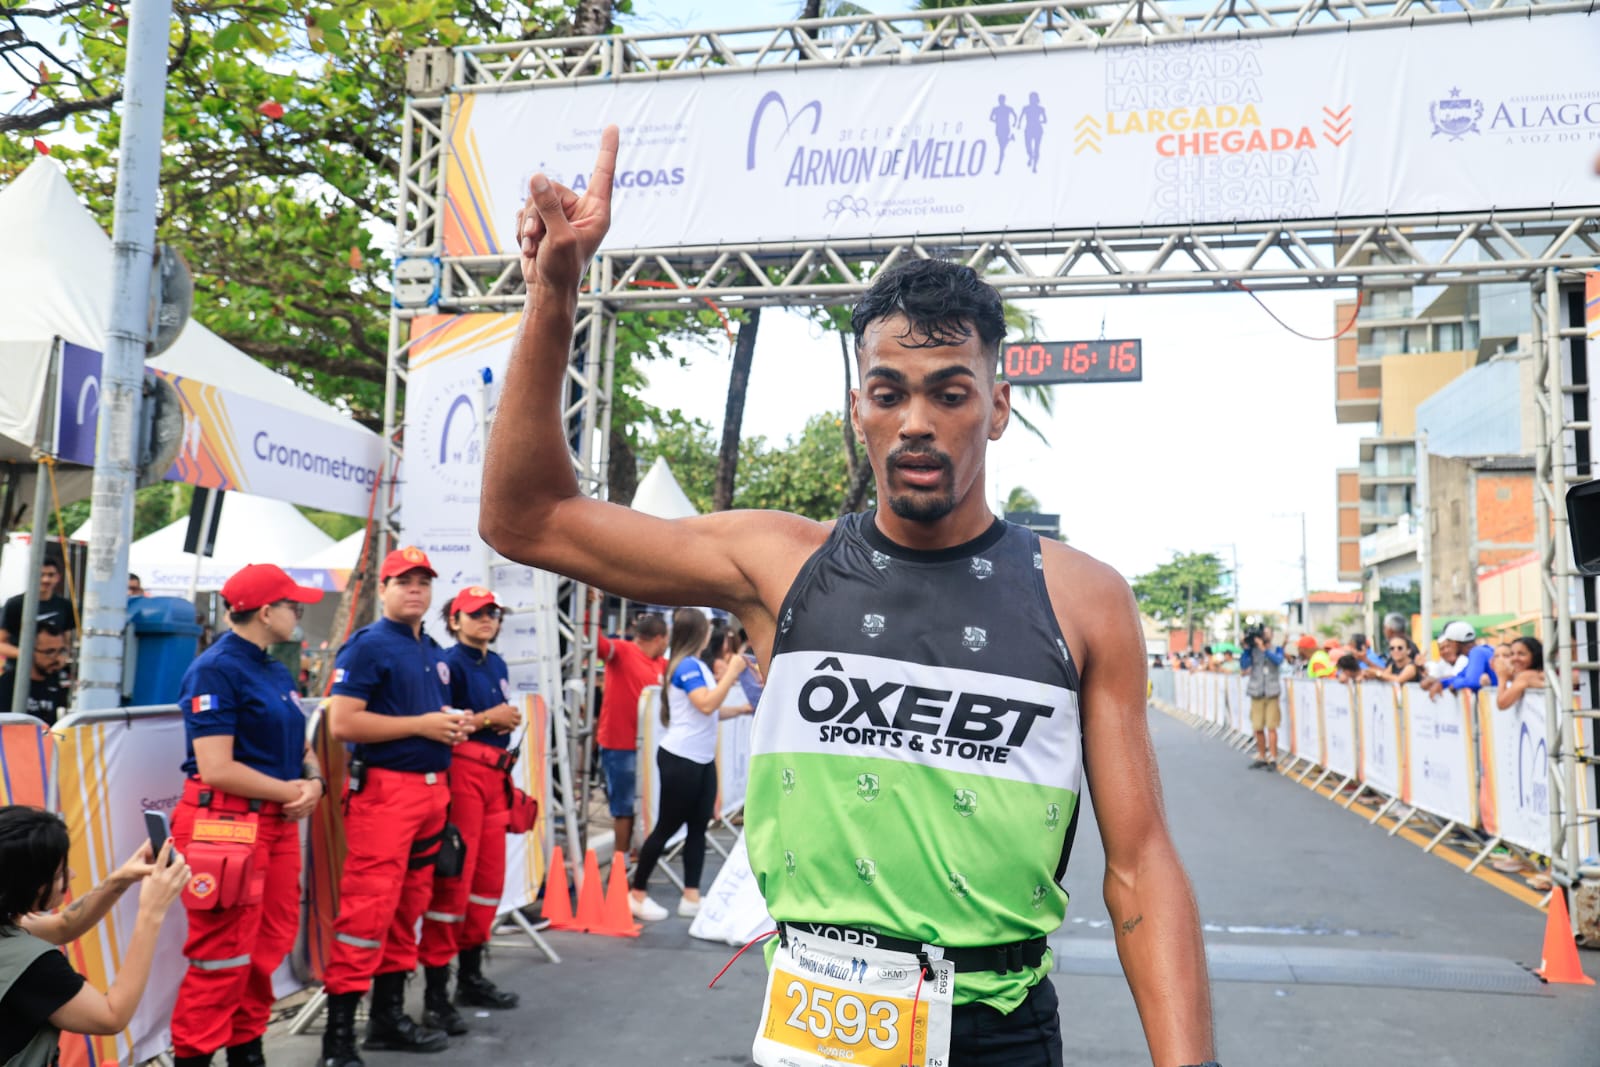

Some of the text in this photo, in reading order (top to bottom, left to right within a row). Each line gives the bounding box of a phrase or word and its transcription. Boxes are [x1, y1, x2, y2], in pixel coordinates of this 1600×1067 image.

[1105, 51, 1263, 85] LARGADA
[1105, 78, 1263, 112] LARGADA
[1106, 103, 1262, 135] LARGADA
[1155, 126, 1317, 157] CHEGADA
[784, 138, 988, 187] ARNON DE MELLO
[1154, 150, 1320, 182] CHEGADA
[1154, 177, 1320, 209] CHEGADA
[797, 656, 1055, 748] ÔXEBT
[818, 725, 1012, 765] SPORTS & STORE
[824, 962, 850, 981] MELLO
[939, 969, 949, 995] 2593
[785, 980, 900, 1051] 2593
